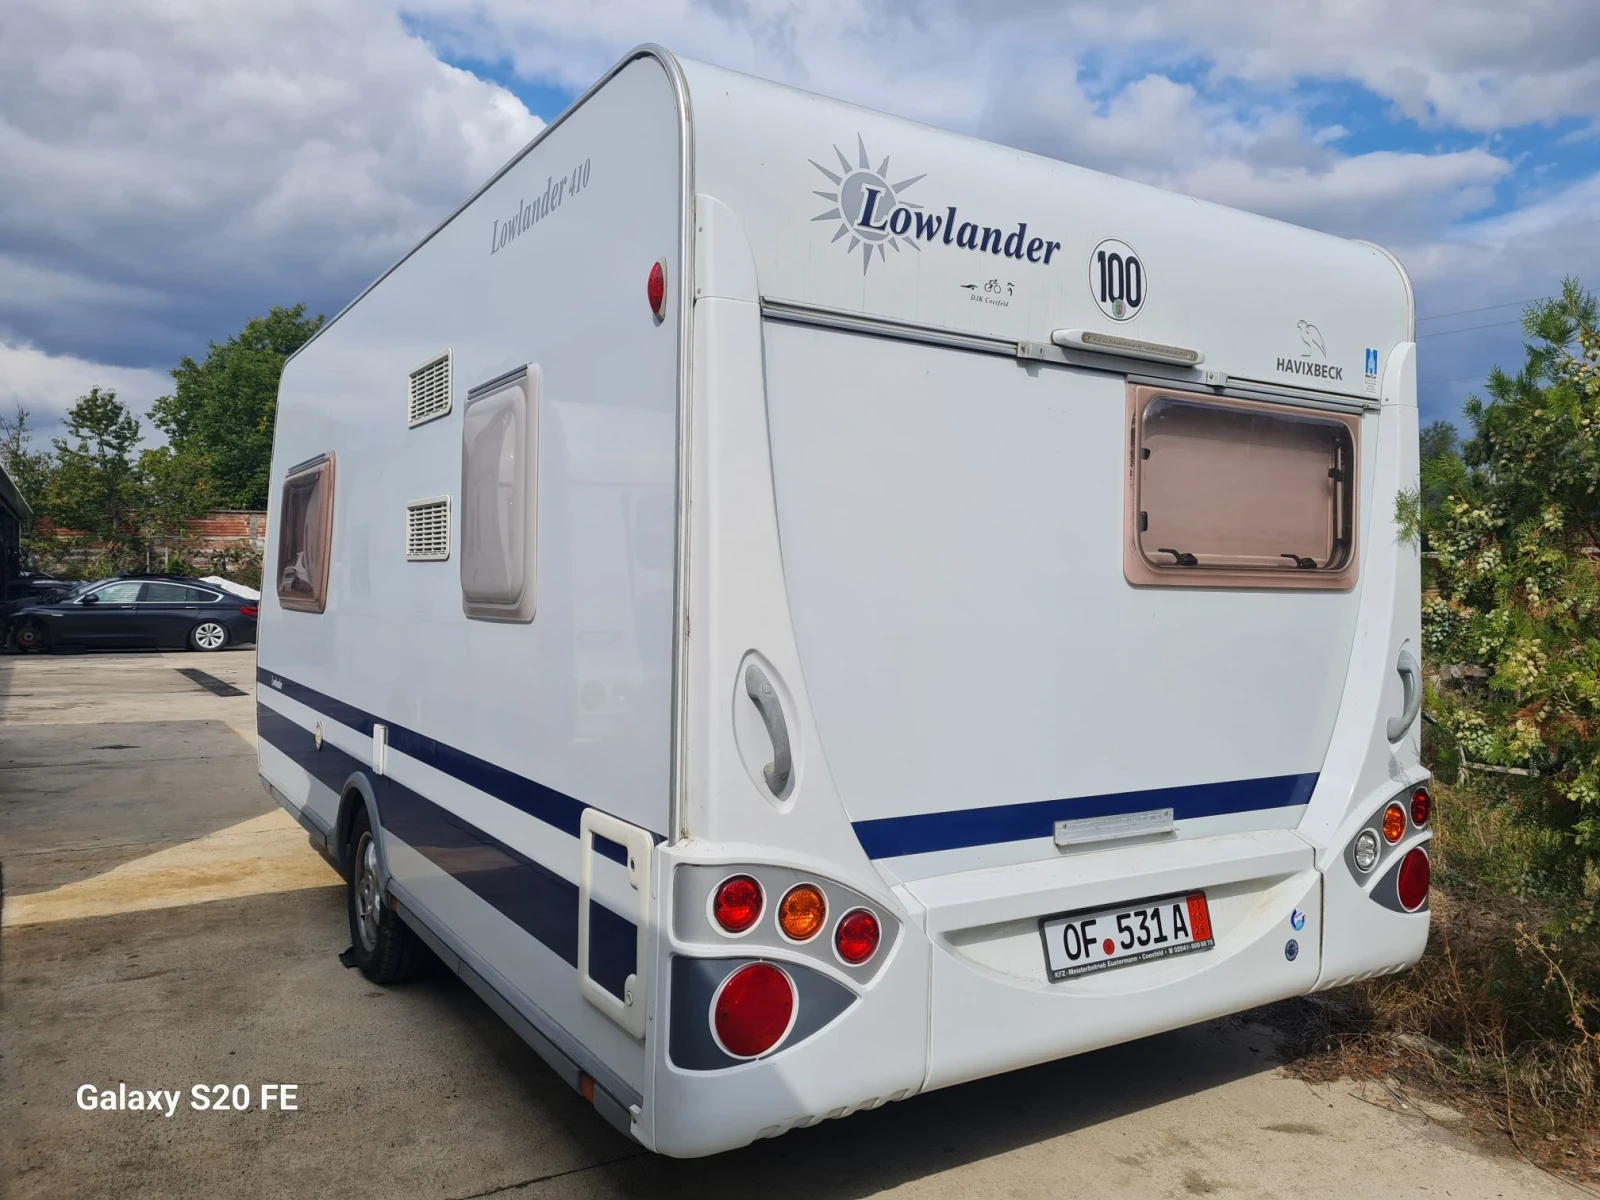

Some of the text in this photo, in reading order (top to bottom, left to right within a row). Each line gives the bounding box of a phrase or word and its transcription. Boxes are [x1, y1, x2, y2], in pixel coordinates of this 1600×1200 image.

[490, 158, 591, 255] Lowlander 410
[857, 187, 1061, 265] Lowlander
[1097, 250, 1142, 308] 100
[1276, 357, 1343, 381] HAVIXBECK
[1063, 904, 1189, 961] OF 531 A
